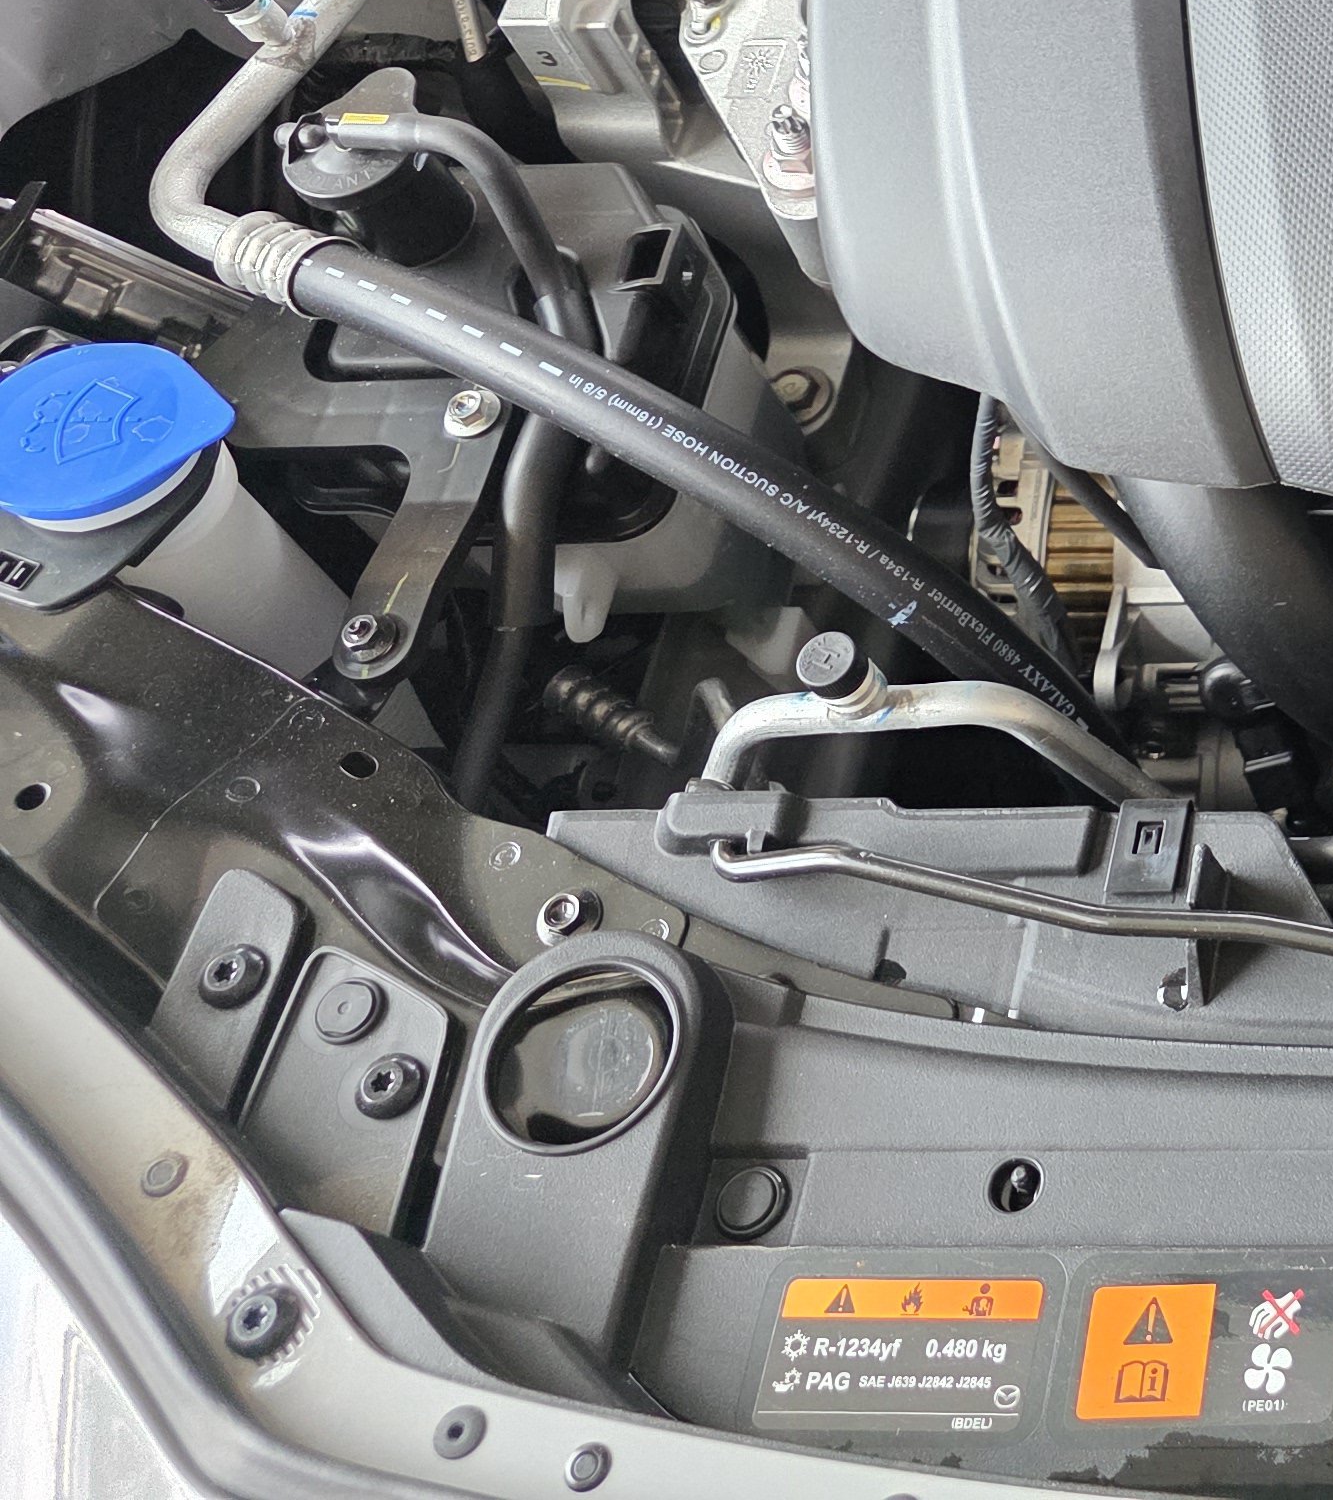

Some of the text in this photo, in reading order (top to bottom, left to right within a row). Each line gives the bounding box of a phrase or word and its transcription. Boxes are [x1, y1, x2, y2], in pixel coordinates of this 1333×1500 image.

[588, 381, 612, 406] 5/8
[607, 388, 665, 430] (16mm)
[661, 424, 710, 458] HOSE
[707, 451, 779, 497] SUCTION
[778, 491, 811, 517] A/C
[806, 506, 871, 554] R-1234yf
[879, 554, 925, 593] R-134a
[928, 588, 998, 647] FlexBarrier
[993, 640, 1021, 666] 4880
[1019, 663, 1075, 719] GALAXY
[813, 1336, 1007, 1364] R-1234yf 0.480 kg
[805, 1371, 991, 1390] PAG SAE J639 J2842 J2845
[1242, 1397, 1286, 1412] (PE01)
[951, 1415, 993, 1431] (BDEL)
